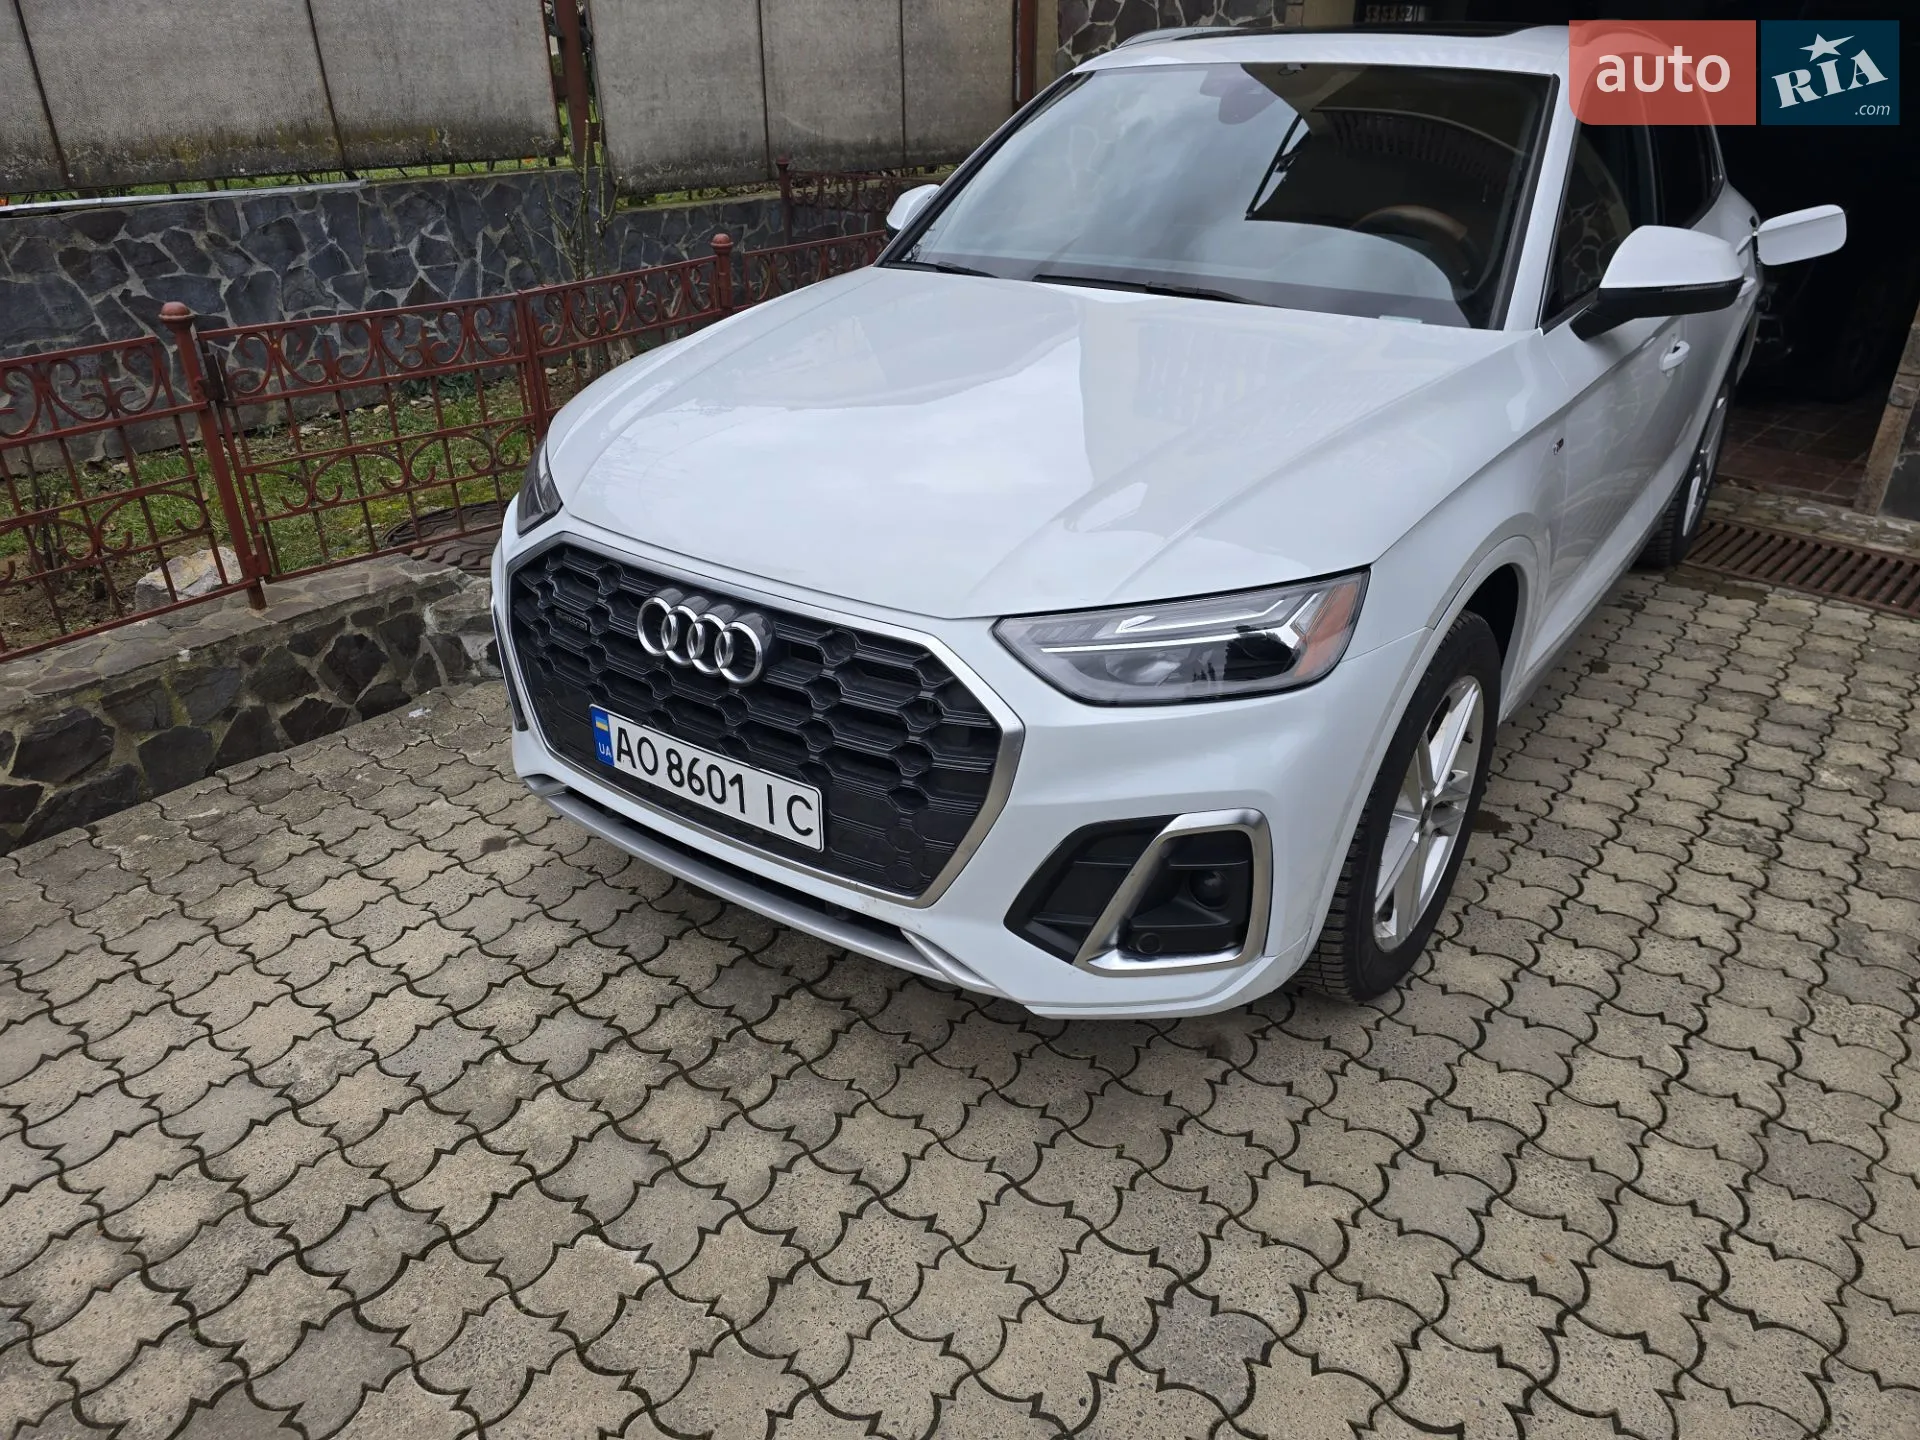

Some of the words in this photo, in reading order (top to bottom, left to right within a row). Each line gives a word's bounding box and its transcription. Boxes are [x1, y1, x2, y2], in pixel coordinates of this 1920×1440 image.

[598, 741, 612, 758] UA
[616, 726, 659, 776] AO
[665, 748, 746, 814] 8601
[766, 783, 814, 837] IC
